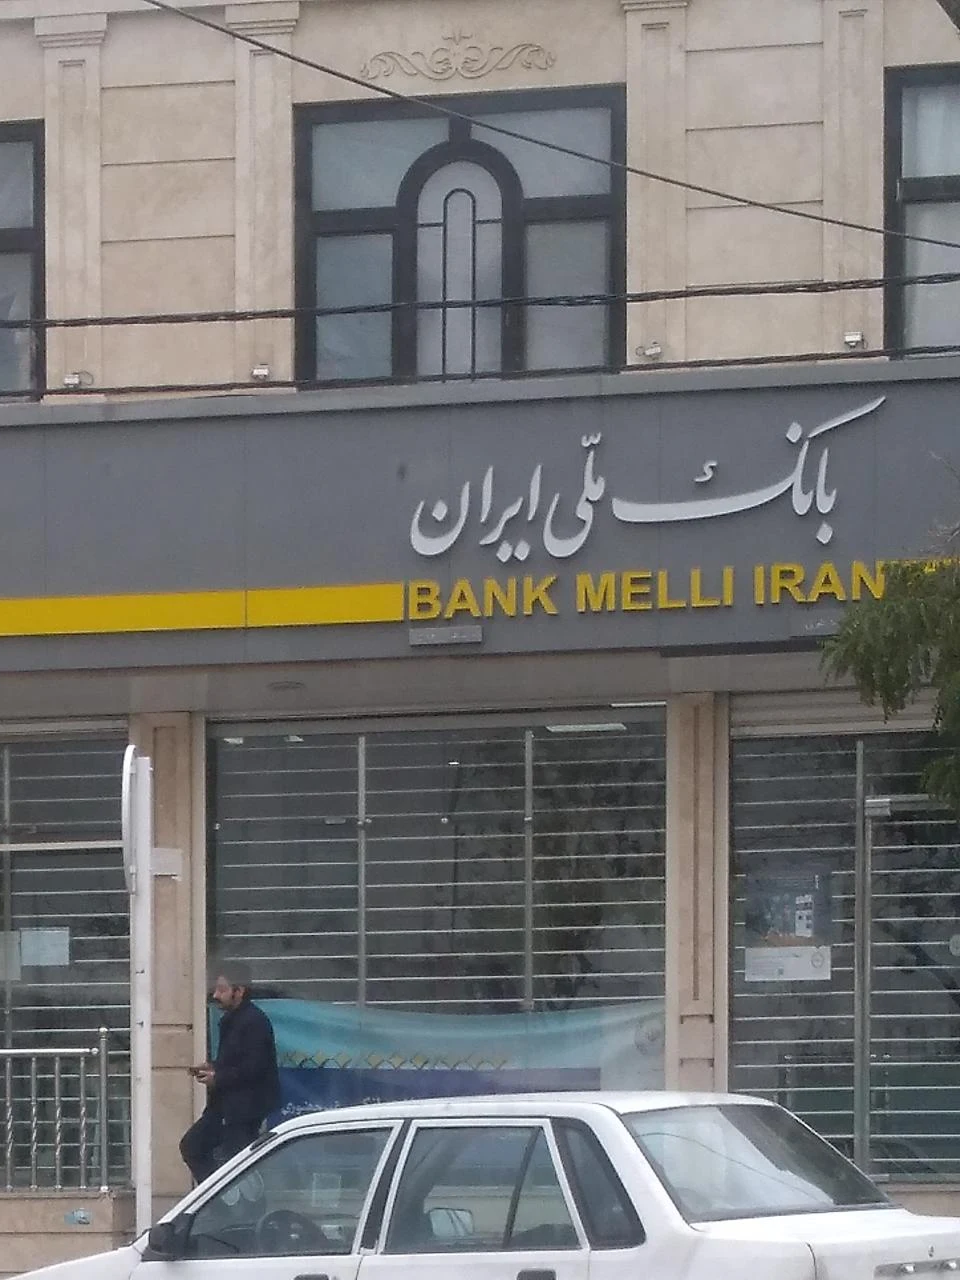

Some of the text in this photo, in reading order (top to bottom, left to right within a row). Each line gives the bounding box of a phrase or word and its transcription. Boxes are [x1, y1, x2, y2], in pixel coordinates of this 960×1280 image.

[409, 463, 541, 563] ایران
[611, 396, 887, 546] بانک
[408, 560, 888, 621] BANK MELLI IRAN
